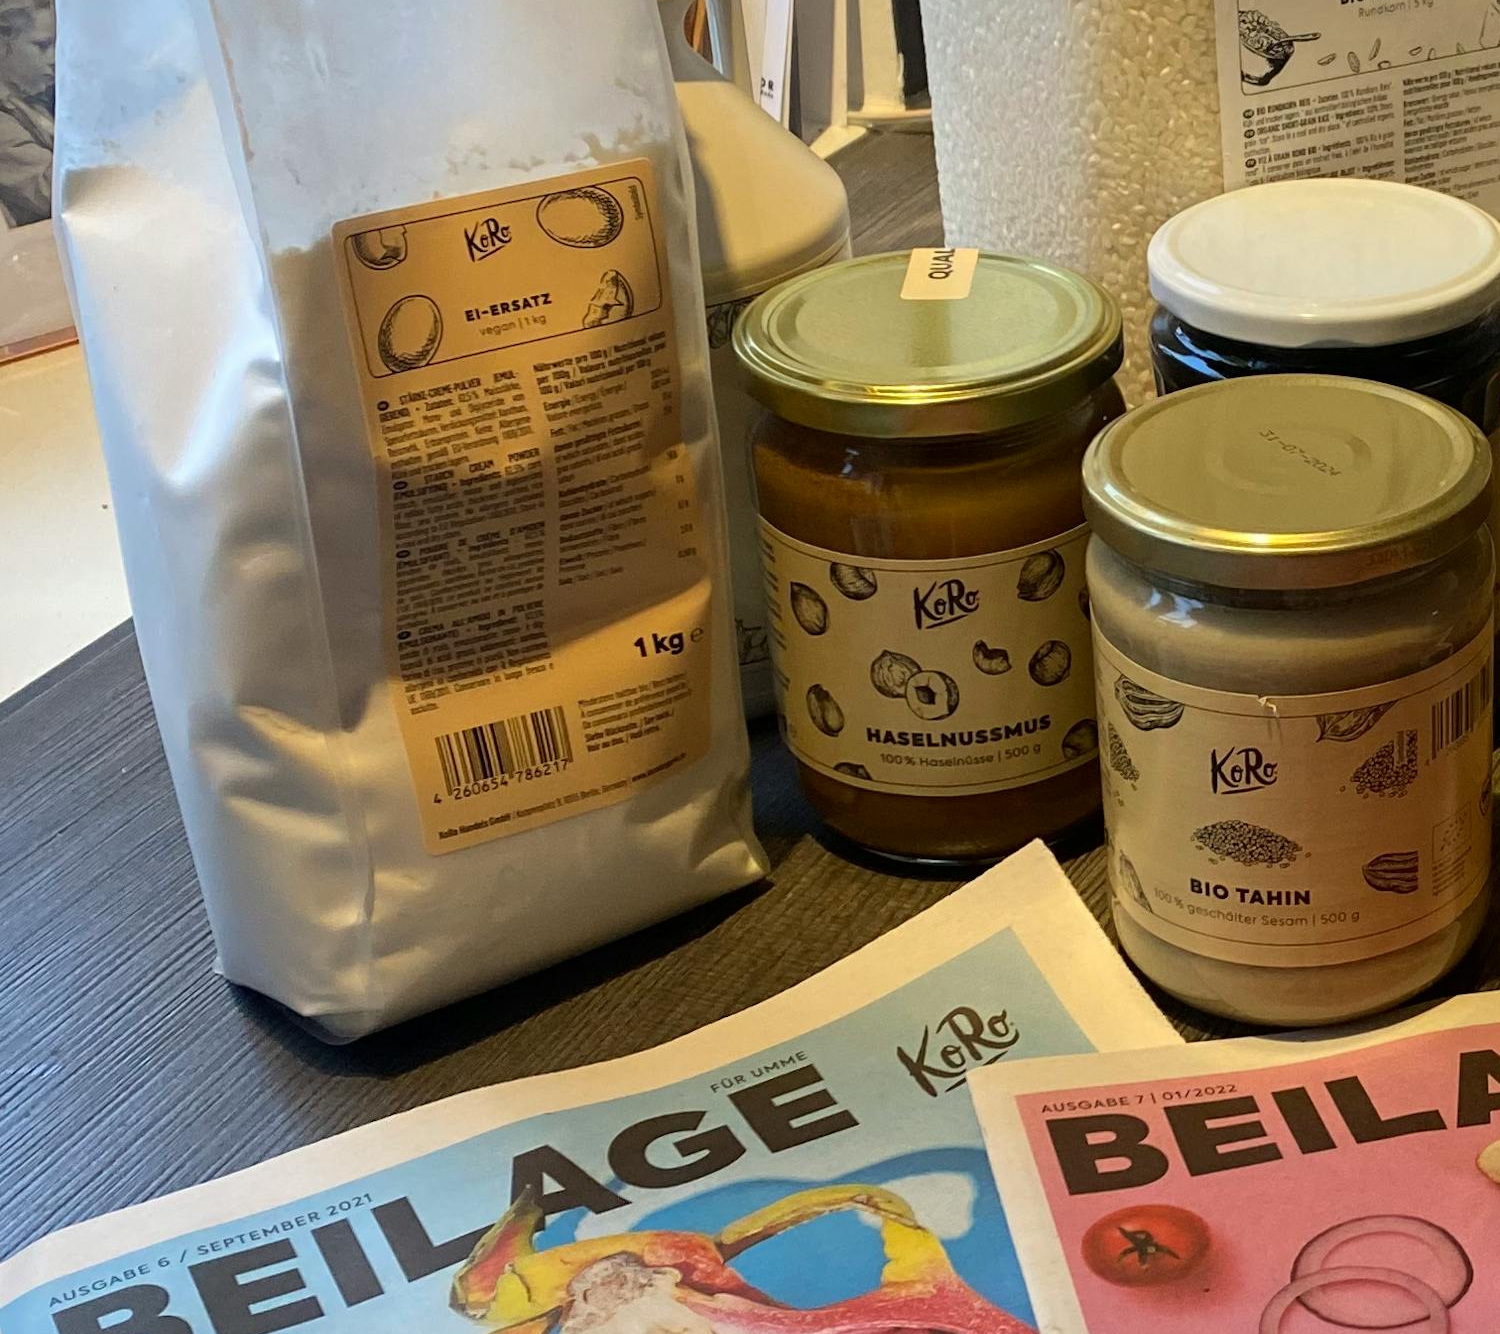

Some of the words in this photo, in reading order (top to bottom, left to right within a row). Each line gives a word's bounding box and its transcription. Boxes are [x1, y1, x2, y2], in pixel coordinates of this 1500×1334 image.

[464, 218, 512, 262] KoRo
[465, 293, 552, 322] EI-ERSATZ
[478, 320, 516, 336] vegan
[532, 315, 547, 326] kg
[913, 578, 980, 629] KoRo
[634, 637, 648, 658] 1
[652, 632, 684, 655] kg
[865, 714, 1052, 748] HASELNUSSMUS
[919, 753, 994, 767] Haselnüsse
[1210, 746, 1278, 794] KoRo
[453, 777, 509, 801] 260654
[515, 757, 570, 782] 786217
[1190, 878, 1229, 900] BIO
[1235, 888, 1311, 906] TAHIN
[1186, 903, 1257, 925] geschälter
[1262, 914, 1308, 927] Sesam
[1320, 911, 1347, 924] 500
[1351, 910, 1360, 923] g
[896, 1006, 1020, 1097] KoRo
[709, 1074, 746, 1093] FÜR
[751, 1050, 809, 1078] UMME
[1041, 1096, 1130, 1114] AUSGABE
[1136, 1095, 1145, 1105] 7
[1162, 1083, 1238, 1102] 01/2022
[49, 1264, 151, 1307] AUSGABE
[157, 1256, 171, 1268] 6
[197, 1211, 321, 1256] SEPTEMBER
[328, 1192, 374, 1217] 2021
